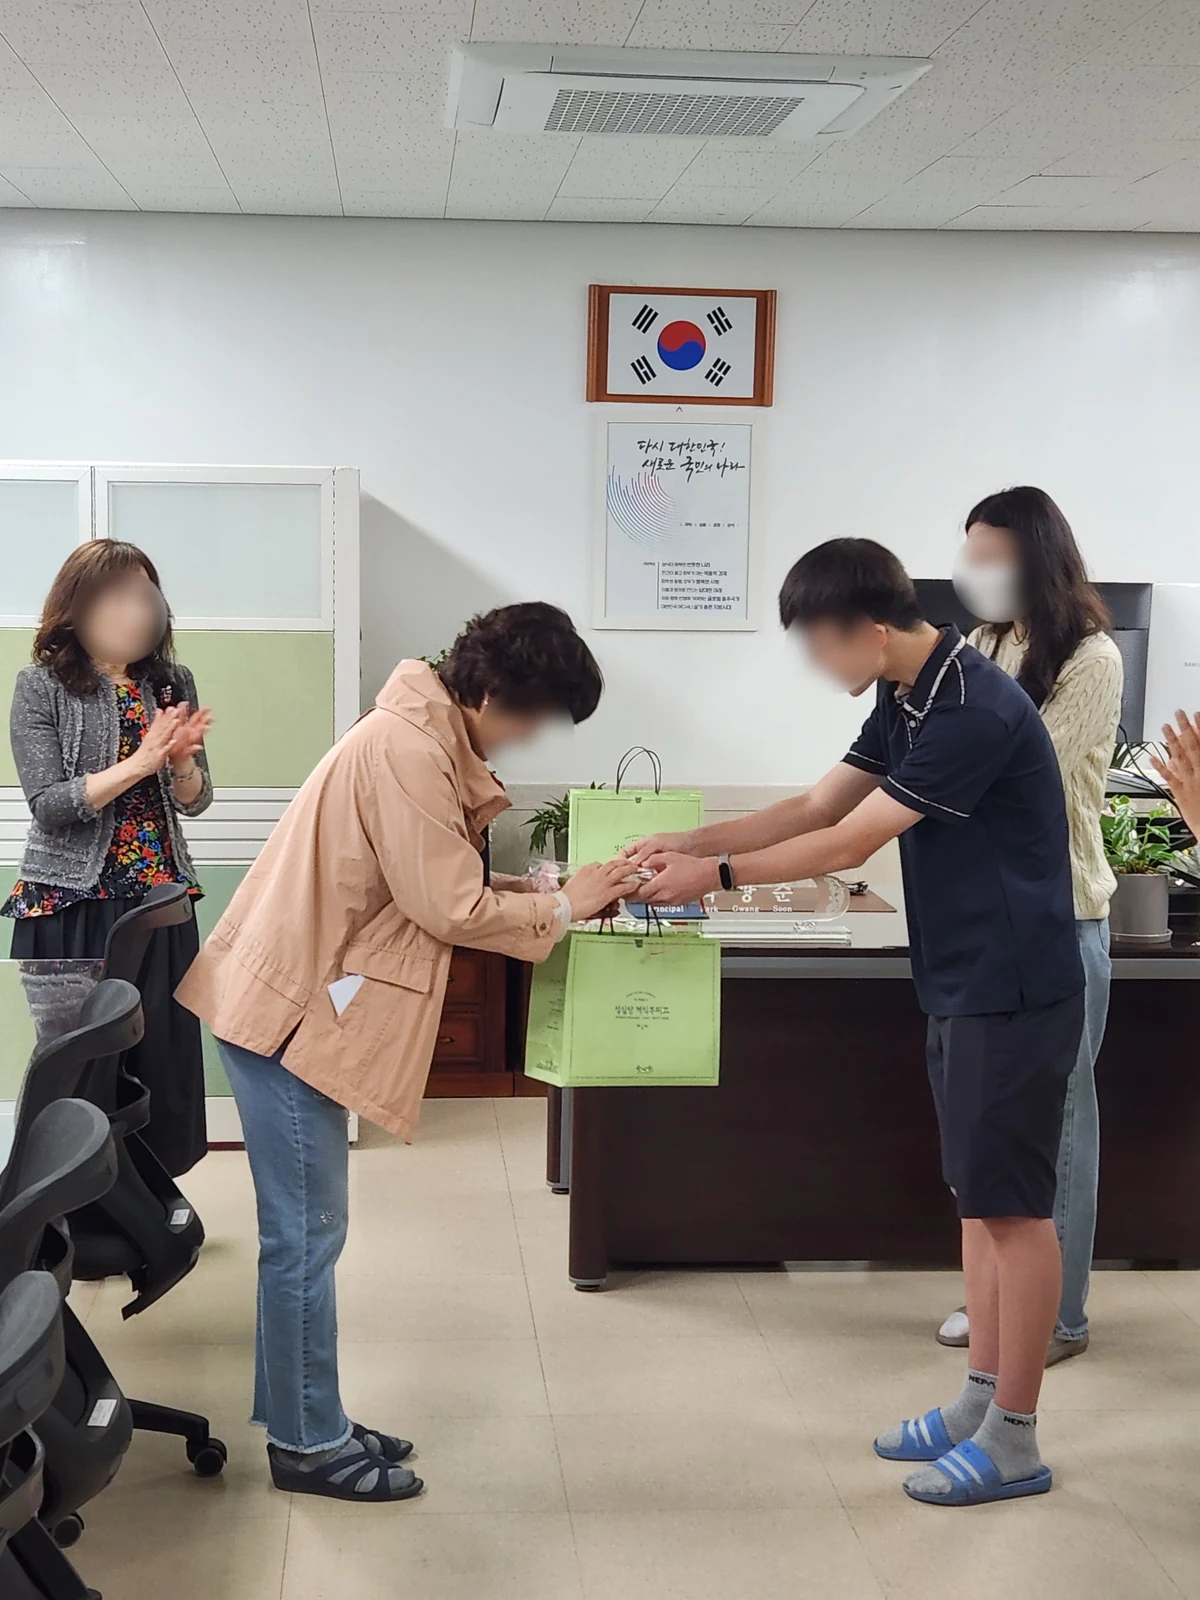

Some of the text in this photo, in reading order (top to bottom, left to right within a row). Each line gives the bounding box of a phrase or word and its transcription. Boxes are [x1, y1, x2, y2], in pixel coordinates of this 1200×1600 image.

[637, 438, 726, 457] 다시 대한민국!
[642, 456, 745, 482] 새로운 국민의 나라
[732, 905, 760, 913] Gwang
[772, 905, 793, 913] Soon
